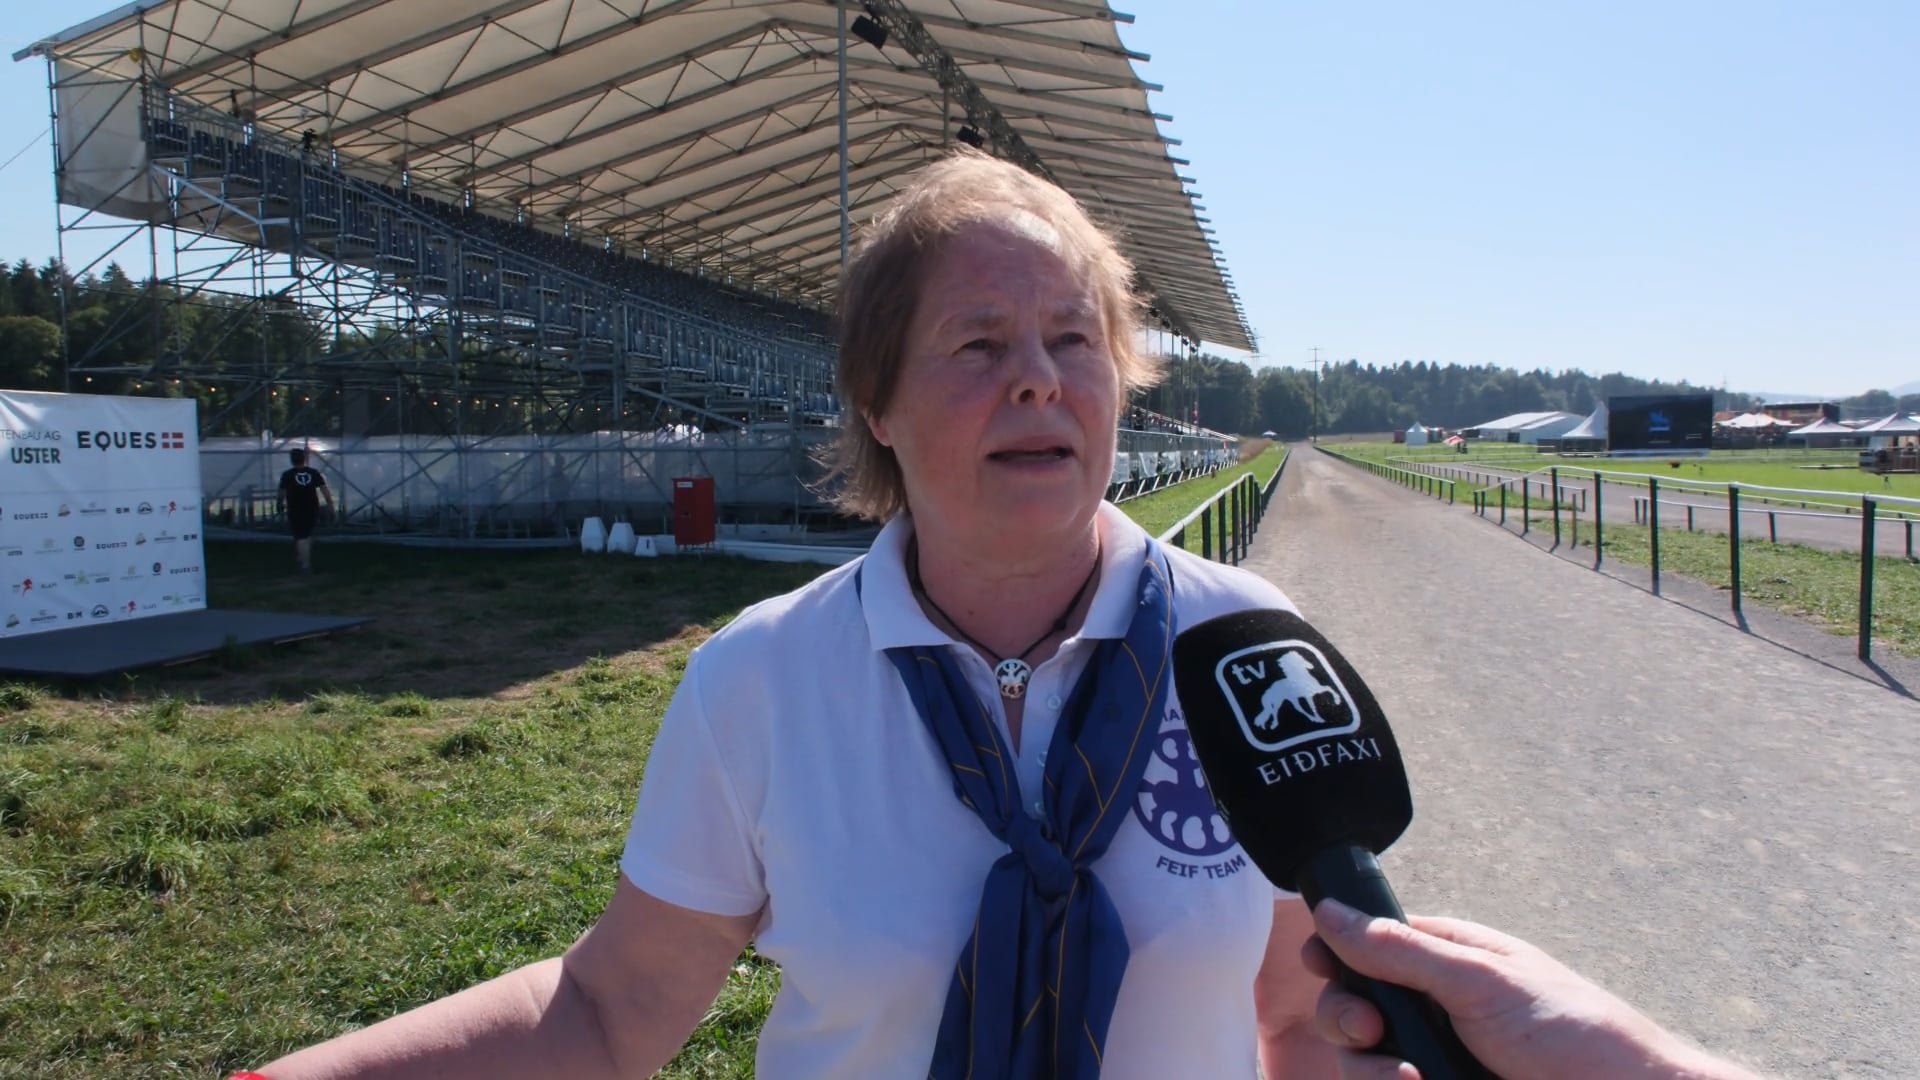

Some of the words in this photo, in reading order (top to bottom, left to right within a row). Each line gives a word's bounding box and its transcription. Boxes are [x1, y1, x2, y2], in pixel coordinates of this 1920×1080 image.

[43, 430, 61, 441] AG
[77, 430, 157, 452] EQUES
[11, 447, 61, 464] USTER
[1231, 659, 1267, 686] tv
[1256, 737, 1383, 786] EIÐFAXI
[1156, 855, 1199, 879] FEIF
[1203, 854, 1247, 880] TEAM
